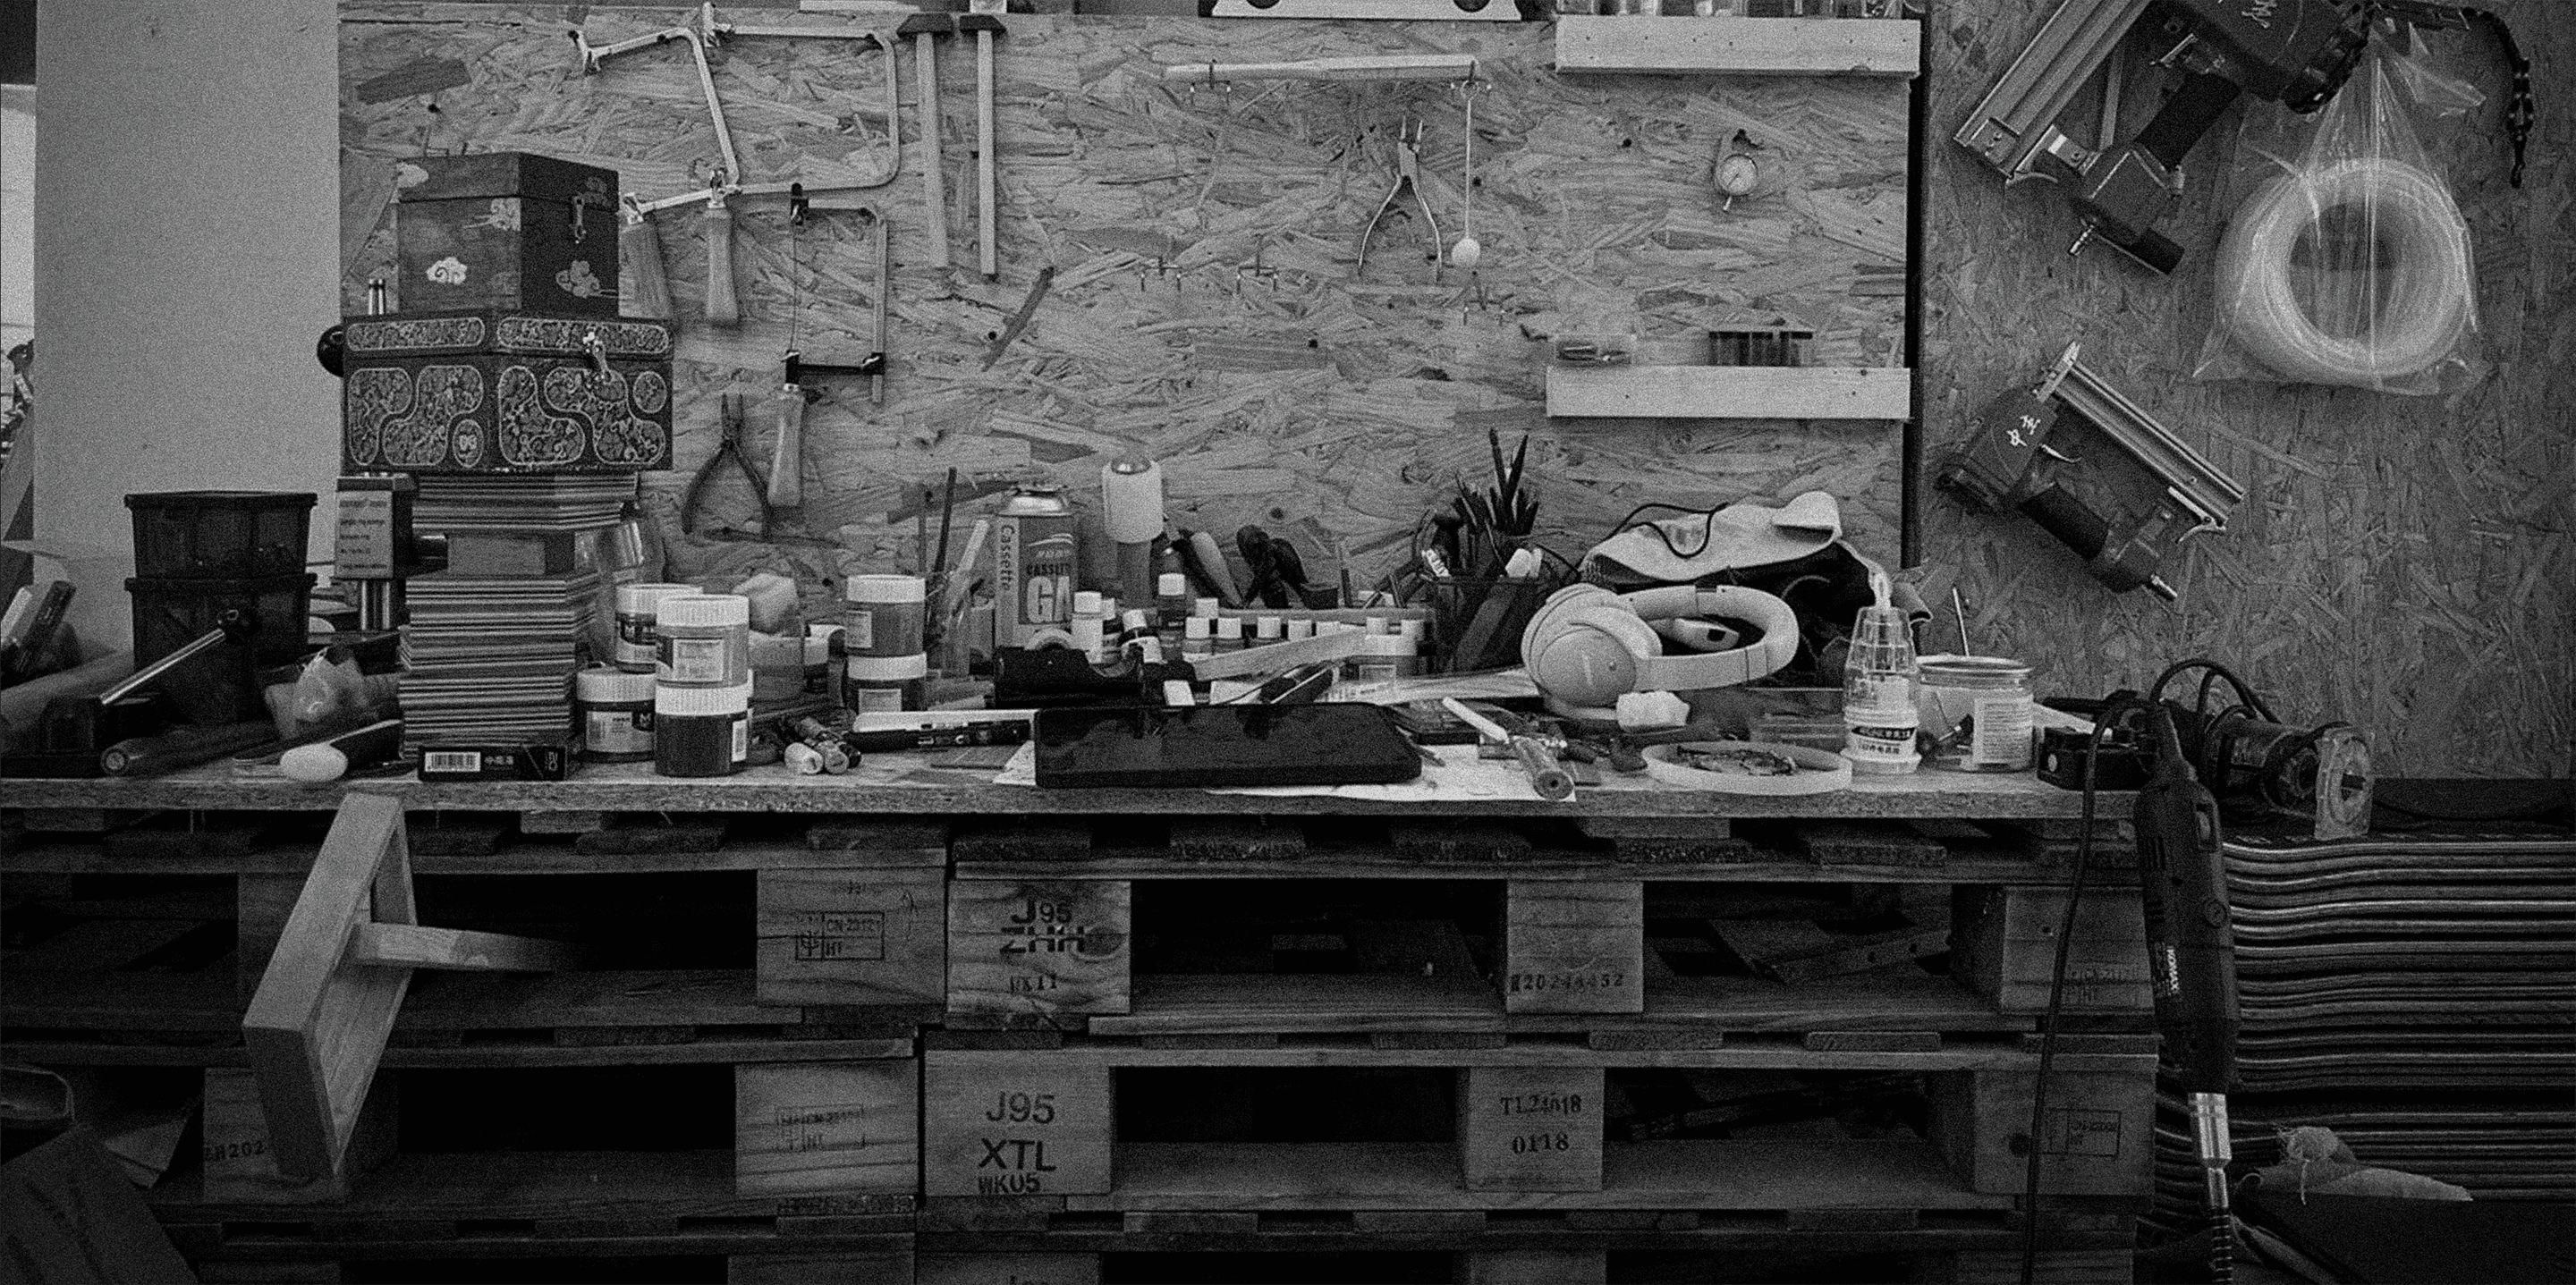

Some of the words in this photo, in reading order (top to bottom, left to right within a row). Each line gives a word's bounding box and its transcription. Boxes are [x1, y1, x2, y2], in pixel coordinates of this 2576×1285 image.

[999, 524, 1016, 592] Cassette
[1011, 898, 1072, 924] J95
[986, 1092, 1055, 1125] J95
[978, 1138, 1057, 1171] XTL
